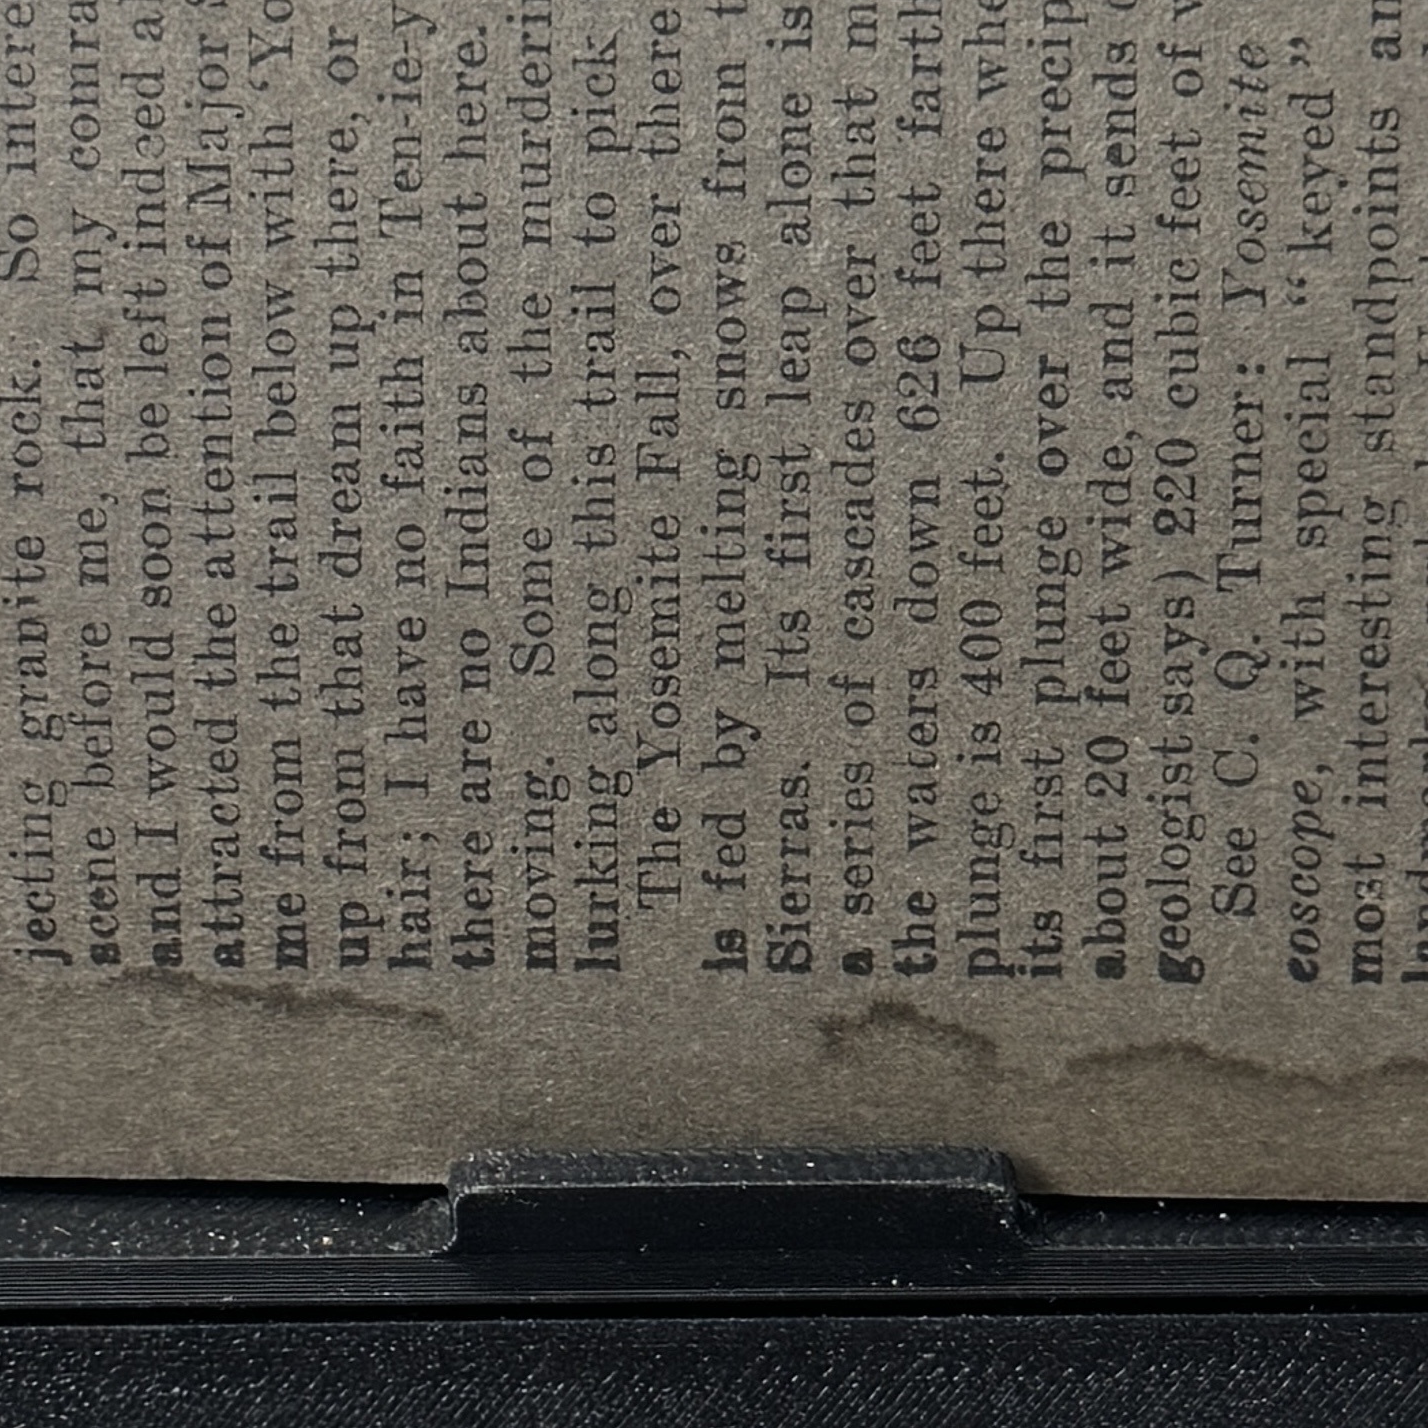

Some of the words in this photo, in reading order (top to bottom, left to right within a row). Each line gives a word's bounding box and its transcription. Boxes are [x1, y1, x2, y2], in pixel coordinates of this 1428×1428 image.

[183, 31, 246, 215] Major
[633, 7, 684, 163] there
[699, 59, 749, 200] from
[892, 180, 945, 290] feet
[1220, 39, 1273, 310] Yosemite
[183, 233, 235, 292] of
[376, 268, 426, 325] in
[647, 191, 683, 317] over
[1351, 104, 1416, 455] standpoints
[504, 291, 554, 384] the
[714, 239, 749, 411] snows
[893, 332, 942, 433] 626
[185, 312, 237, 581] attention
[377, 354, 426, 495] faith
[506, 426, 555, 484] of
[632, 347, 692, 484] Fall,
[1212, 360, 1268, 595] Turner:
[394, 522, 429, 589] no
[507, 526, 557, 677] Some
[694, 447, 762, 671] melting
[891, 473, 943, 625] down
[191, 601, 240, 692] the
[381, 615, 430, 745] have
[632, 514, 684, 776] Yosemite
[1210, 632, 1274, 692] Q.
[1340, 494, 1407, 812] interesting
[382, 771, 431, 798] I
[698, 706, 763, 775] by
[890, 664, 940, 854] waters
[1211, 732, 1261, 789] C.
[191, 714, 248, 969] attracted
[380, 830, 442, 973] hair;
[508, 756, 573, 976] moving.
[634, 805, 684, 912] The
[699, 809, 749, 895] fed
[1200, 825, 1260, 921] See
[889, 889, 940, 979] the
